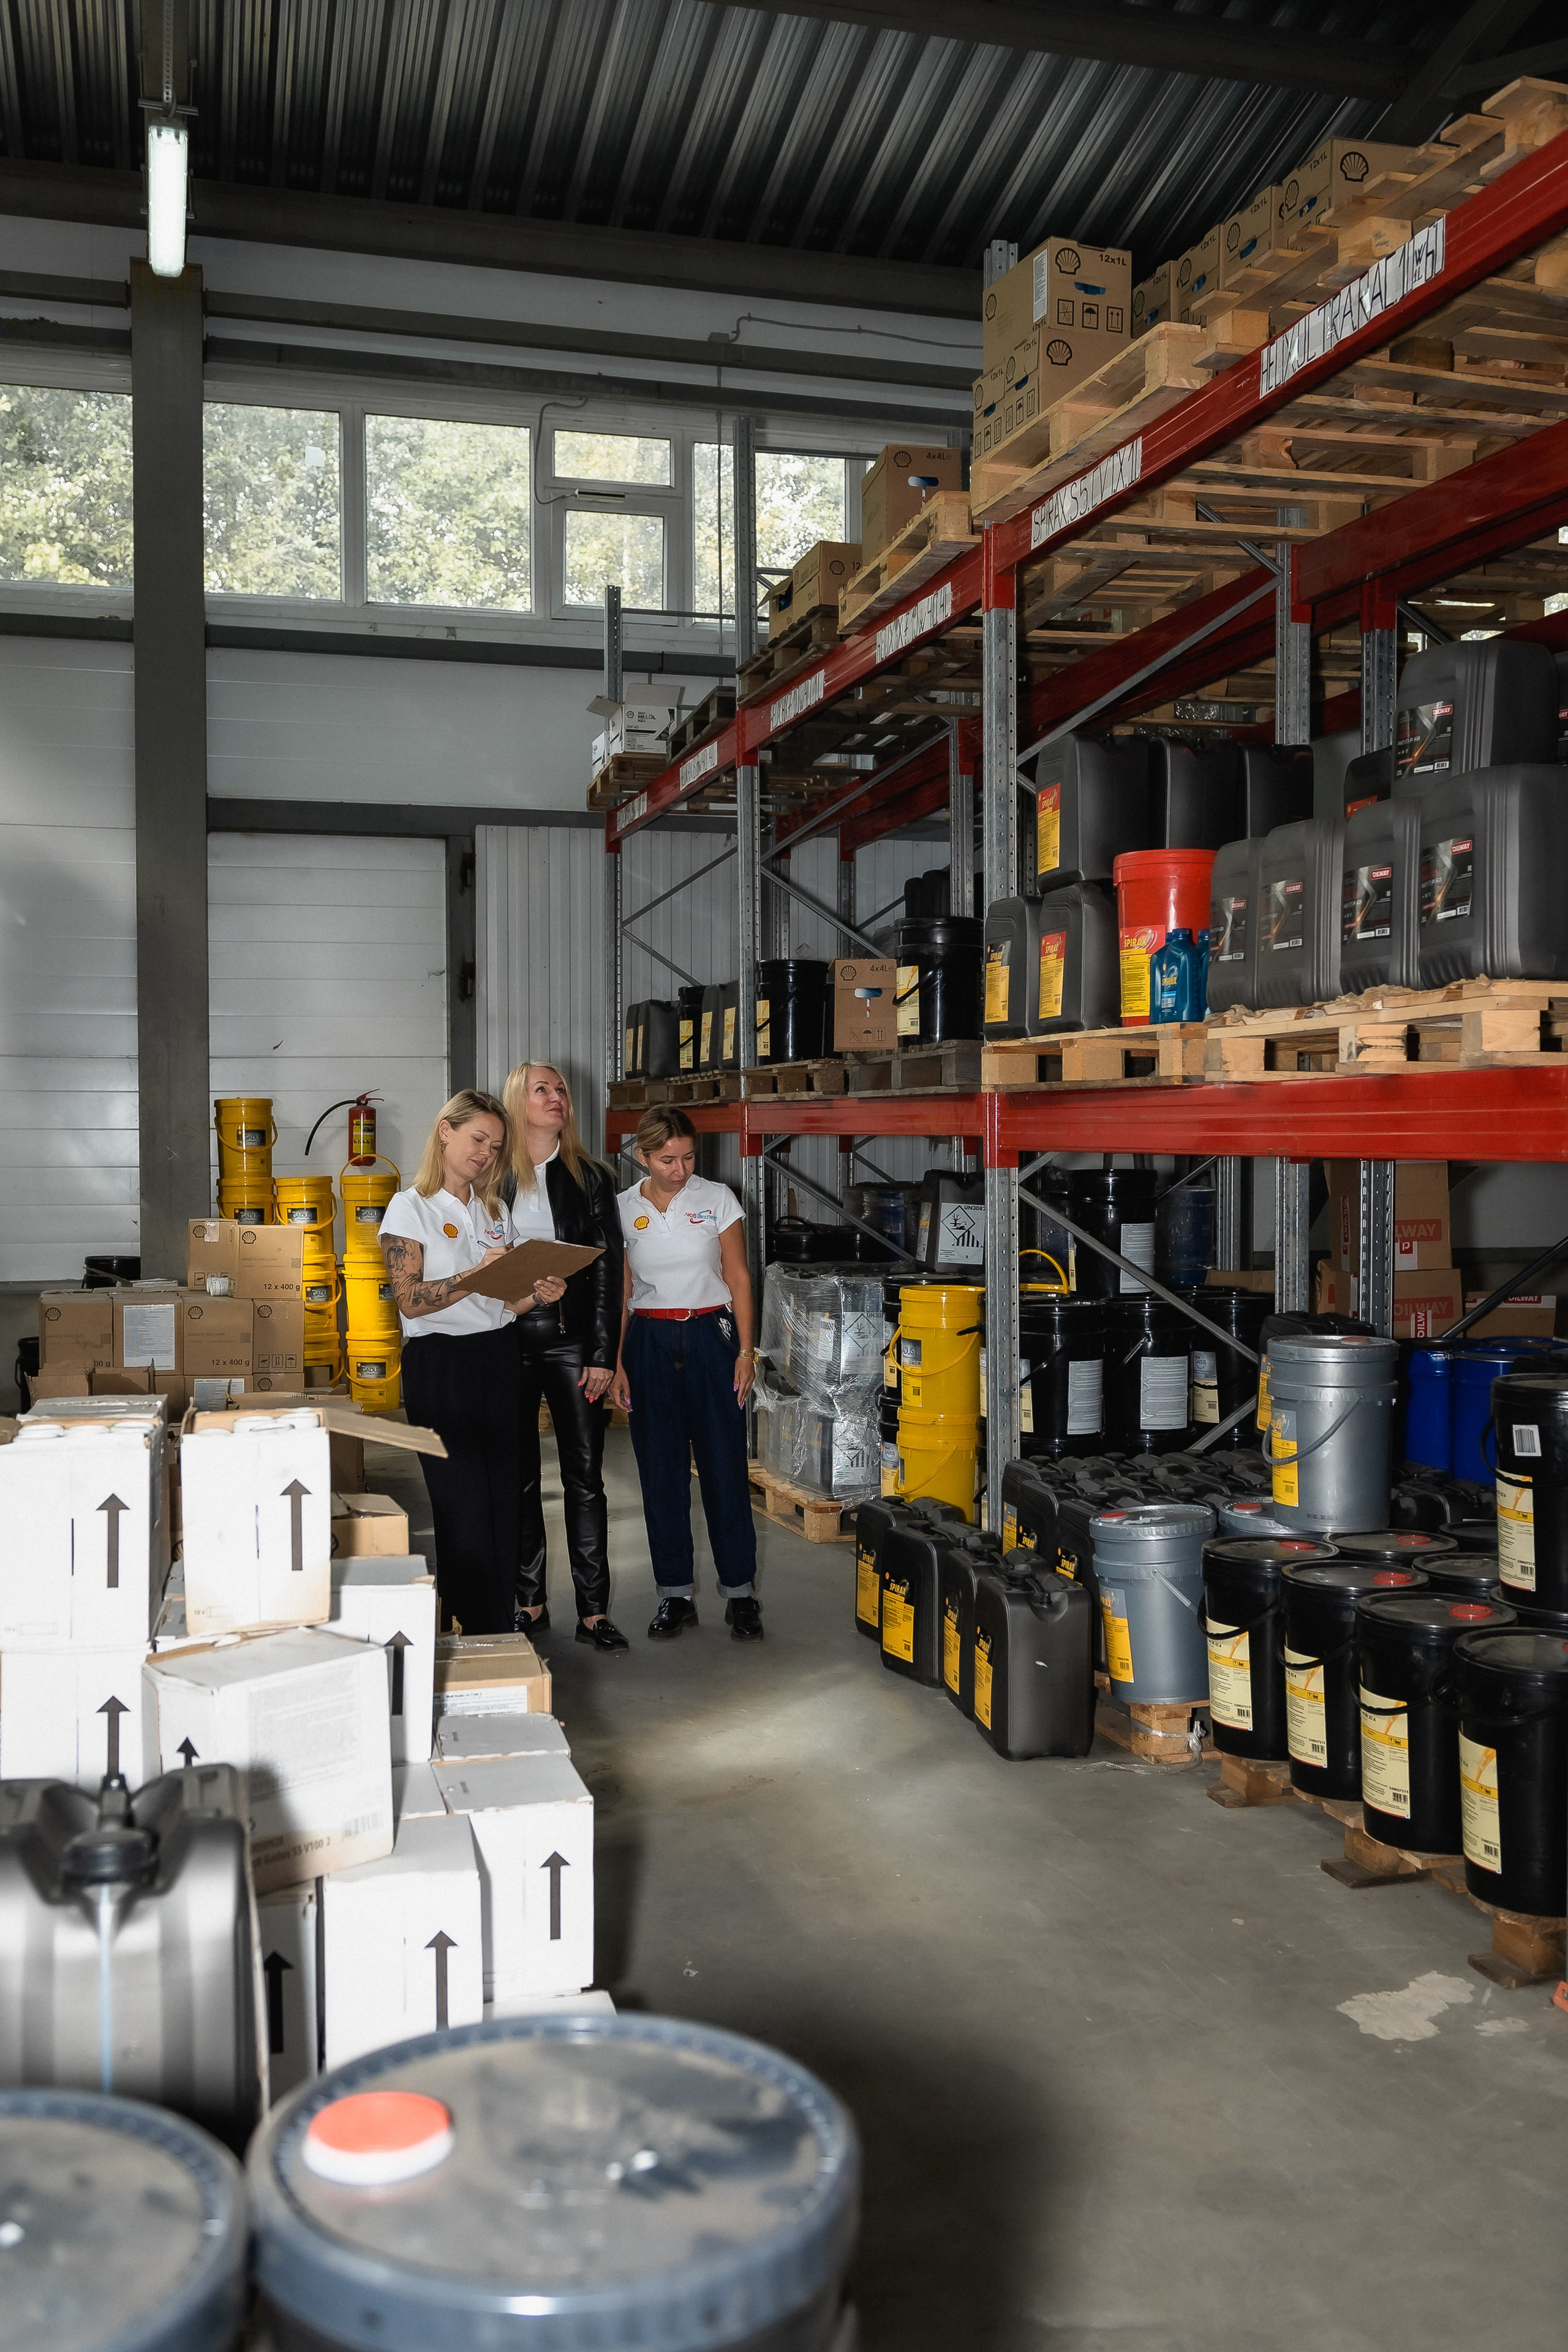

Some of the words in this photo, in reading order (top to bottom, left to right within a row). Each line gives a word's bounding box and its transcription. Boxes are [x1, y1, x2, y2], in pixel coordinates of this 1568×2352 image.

[1310, 151, 1327, 172] 12x1L
[1250, 197, 1267, 215] 12x1L
[1200, 234, 1216, 252] 12x1L
[1099, 254, 1128, 266] 12x1L
[1032, 317, 1047, 333] 12x1L
[1023, 337, 1038, 353] 12x1L
[990, 368, 1004, 382] 12x1L
[1045, 943, 1059, 954] SPIRAX
[1124, 937, 1147, 948] SPIRAX
[990, 951, 1003, 961] SPIRAX
[1162, 976, 1177, 986] SPIRAX
[1022, 1536, 1035, 1550] SPIRAX
[862, 1553, 875, 1564] SPIRAX
[1061, 1558, 1076, 1572] SPIRAX
[890, 1582, 907, 1596] SPIRAX
[948, 1608, 957, 1623] SPIRAX
[979, 1638, 990, 1654] SPIRAX
